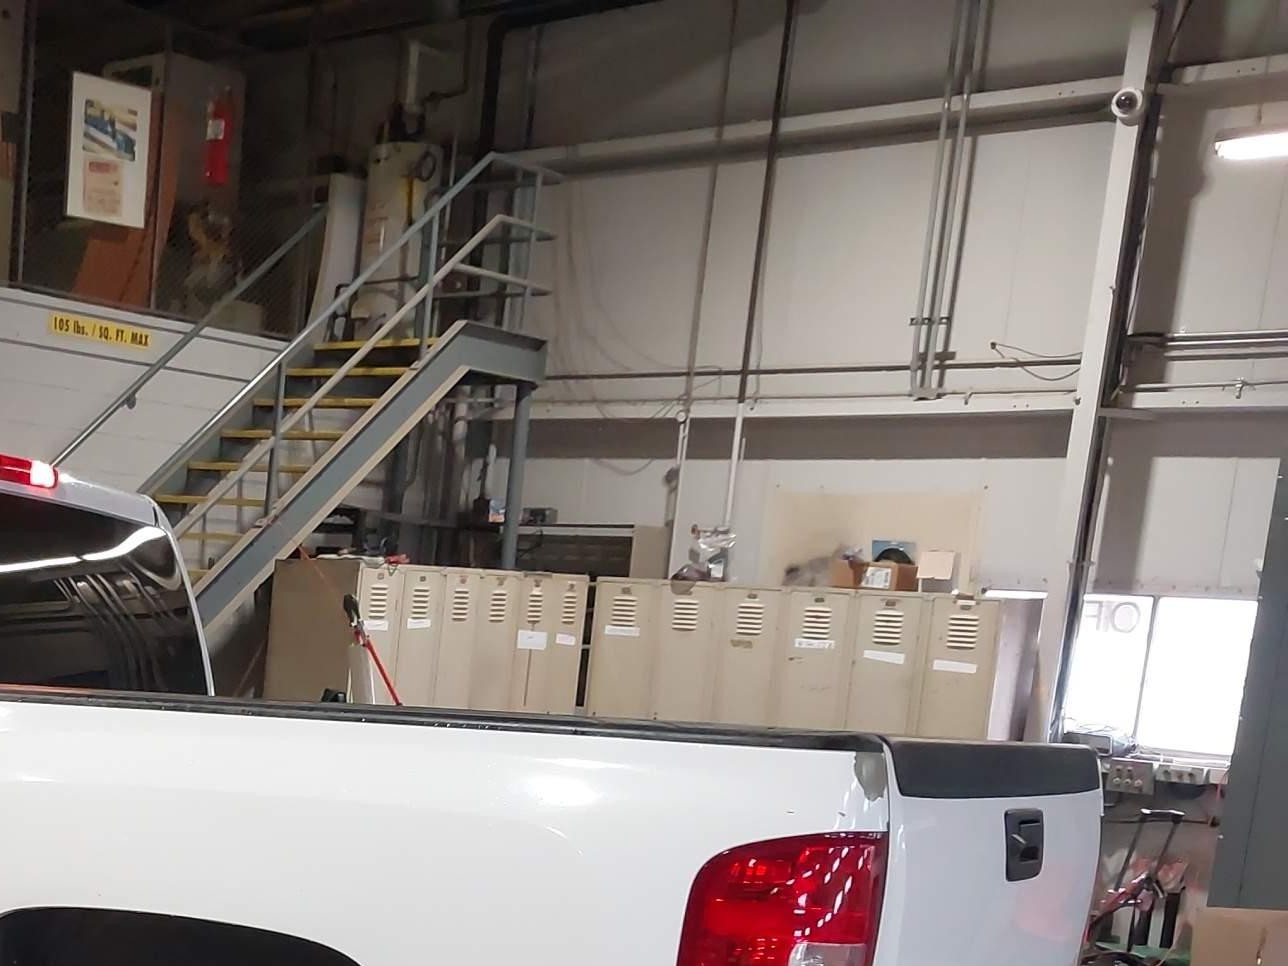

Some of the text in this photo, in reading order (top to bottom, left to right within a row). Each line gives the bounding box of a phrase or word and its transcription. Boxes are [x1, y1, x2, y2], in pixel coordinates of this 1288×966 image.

[54, 317, 71, 332] 105
[73, 320, 89, 336] lbs.
[98, 325, 113, 341] SQ.
[115, 329, 128, 343] FT.
[130, 332, 149, 346] MAX
